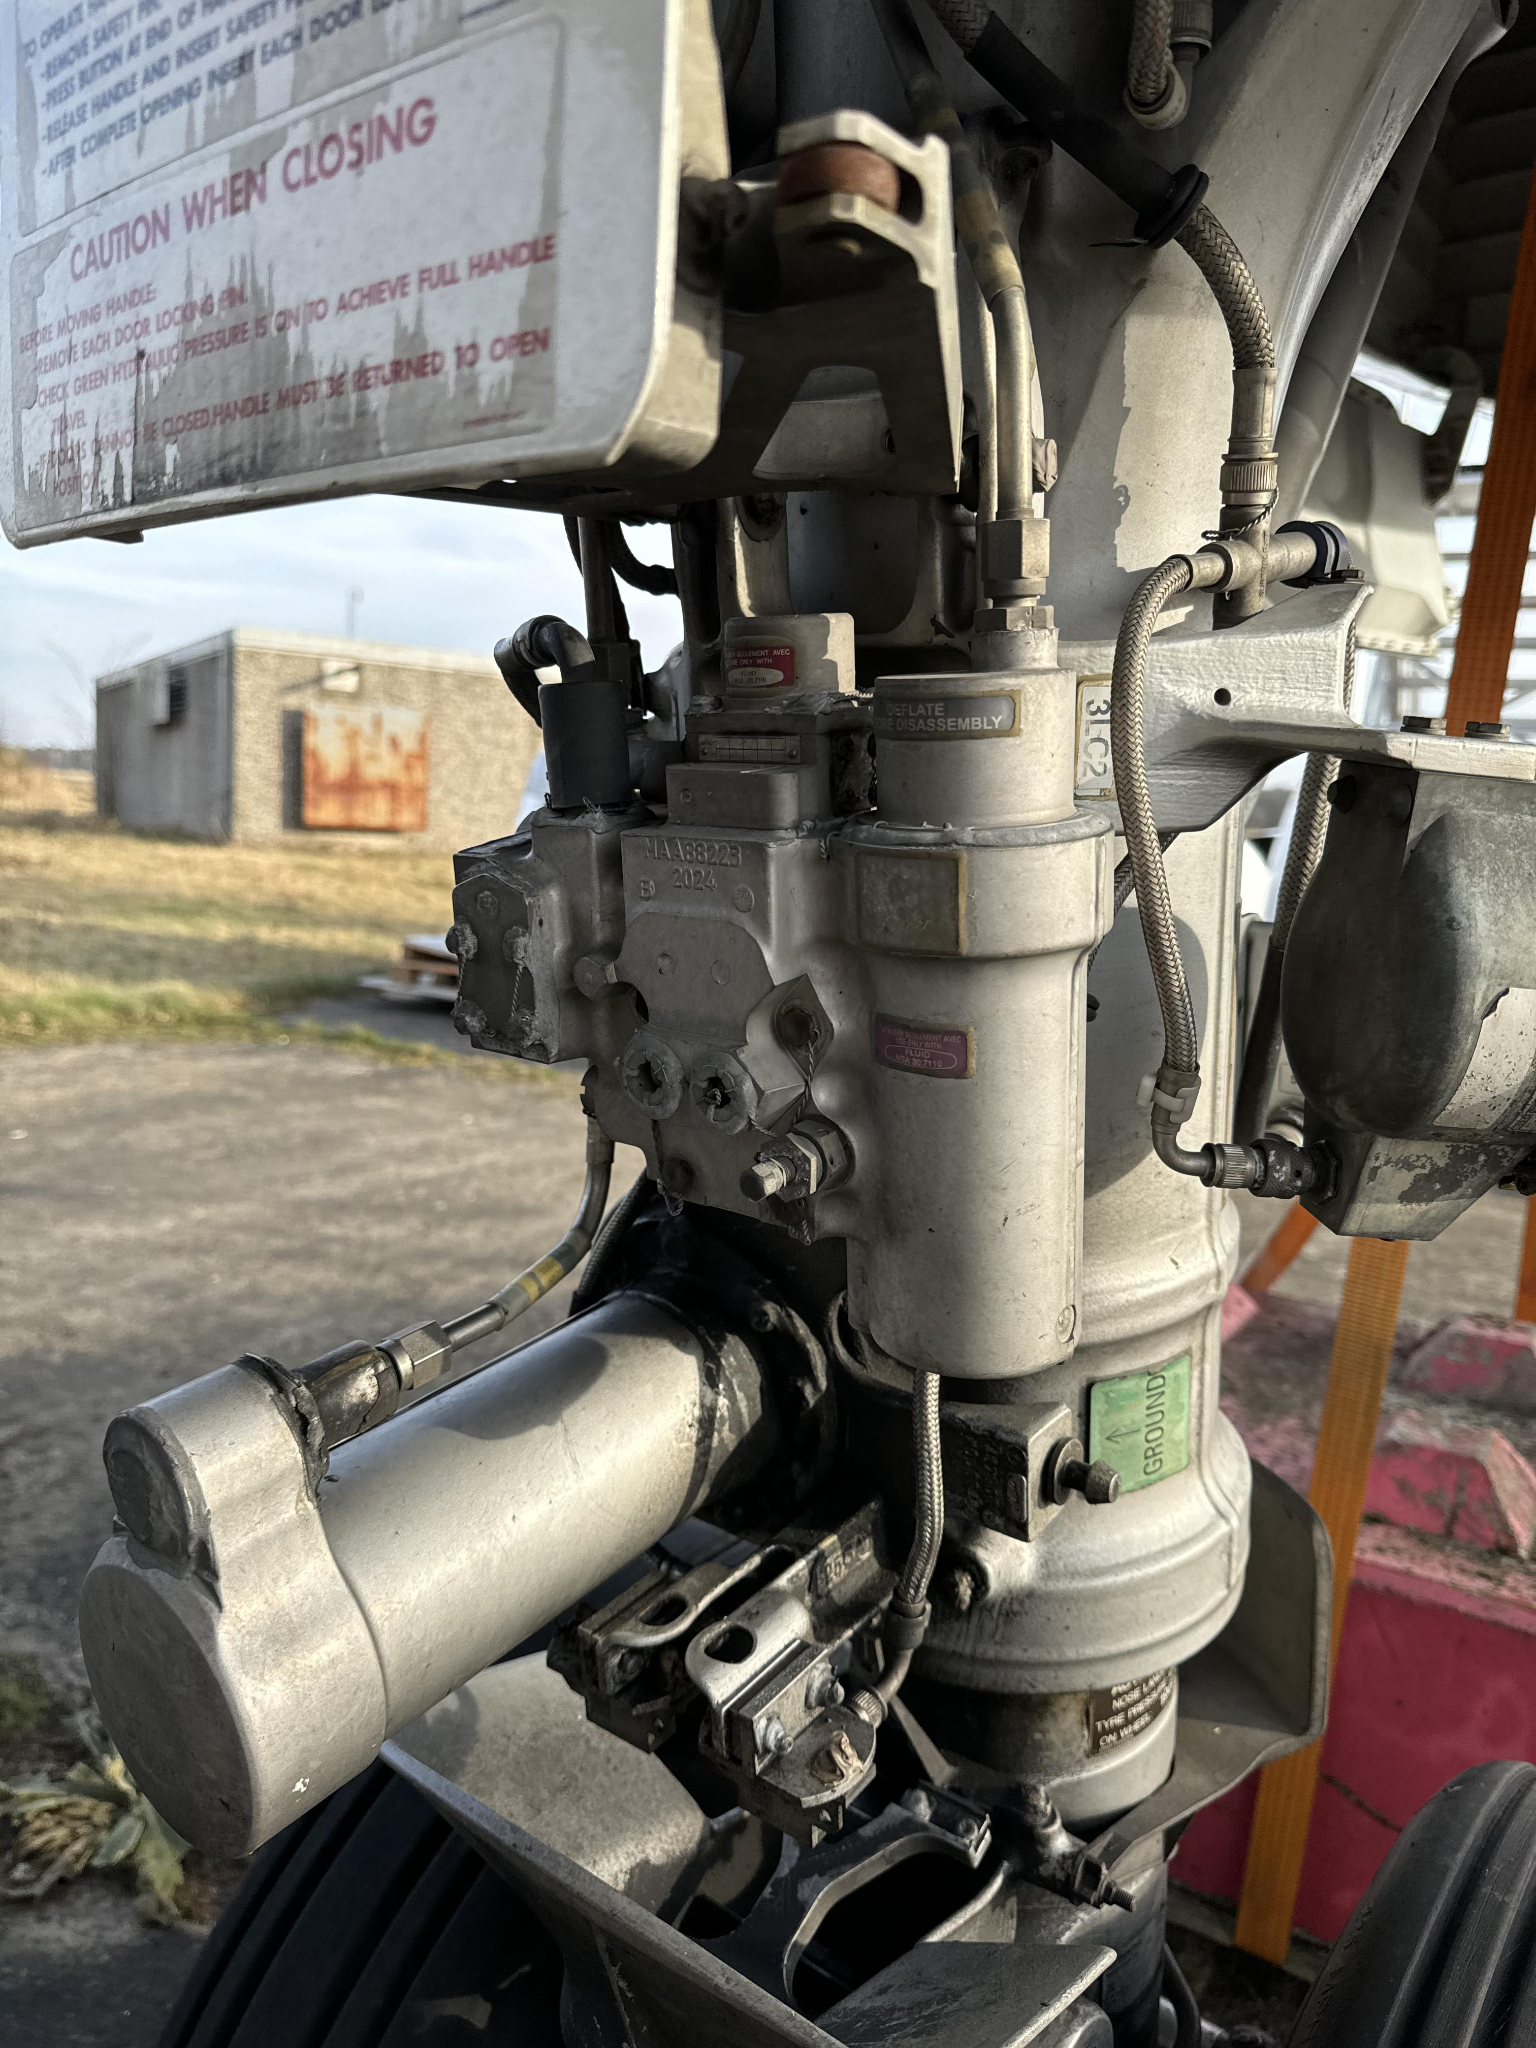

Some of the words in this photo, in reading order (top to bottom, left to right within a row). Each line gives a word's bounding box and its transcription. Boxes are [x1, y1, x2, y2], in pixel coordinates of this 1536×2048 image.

[93, 6, 134, 50] SAFETY
[77, 46, 123, 91] BUTTON
[127, 33, 142, 60] AT
[145, 17, 172, 48] END
[177, 2, 197, 30] OF
[90, 73, 138, 117] HANDLE
[142, 55, 171, 89] AND
[175, 26, 221, 69] INSERT
[226, 1, 278, 43] SAFETY
[80, 110, 138, 158] COMPLETE
[139, 76, 202, 126] OPENING
[207, 48, 256, 92] INSERT
[261, 26, 302, 66] EACH
[310, 1, 364, 43] DOOR
[70, 201, 171, 281] CAUTION
[181, 160, 268, 235] WHEN
[281, 96, 438, 193] CLOSING
[74, 368, 109, 396] GREEN
[184, 322, 249, 361] PRESSURE
[255, 315, 268, 338] IS
[275, 308, 300, 333] ON
[304, 299, 329, 325] TO
[336, 273, 410, 315] ACHIEVE
[418, 260, 461, 293] FULL
[468, 233, 557, 279] HANDLE
[82, 332, 110, 358] EACH
[115, 317, 151, 347] DOOR
[156, 293, 214, 333] LOCKING
[19, 324, 53, 355] BEFORE
[57, 305, 102, 338] MOVING
[277, 379, 318, 410] MUST
[352, 349, 446, 393] RETURNED
[454, 342, 480, 369] TO
[490, 326, 552, 363] OPEN
[772, 648, 790, 656] AVEC
[887, 703, 945, 716] DEFLATE
[896, 716, 1003, 731] DISASSEMBLY
[672, 865, 718, 892] 2024
[905, 1030, 942, 1042] SEULEMENT
[943, 1035, 962, 1043] AVEC
[924, 1041, 942, 1049] WITH
[895, 1053, 911, 1064] NSA
[905, 1048, 931, 1059] FLUID
[1143, 1371, 1166, 1477] GROUND
[1111, 1686, 1142, 1712] NOSE
[1095, 1711, 1127, 1734] TYRE
[1099, 1731, 1118, 1747] ON
